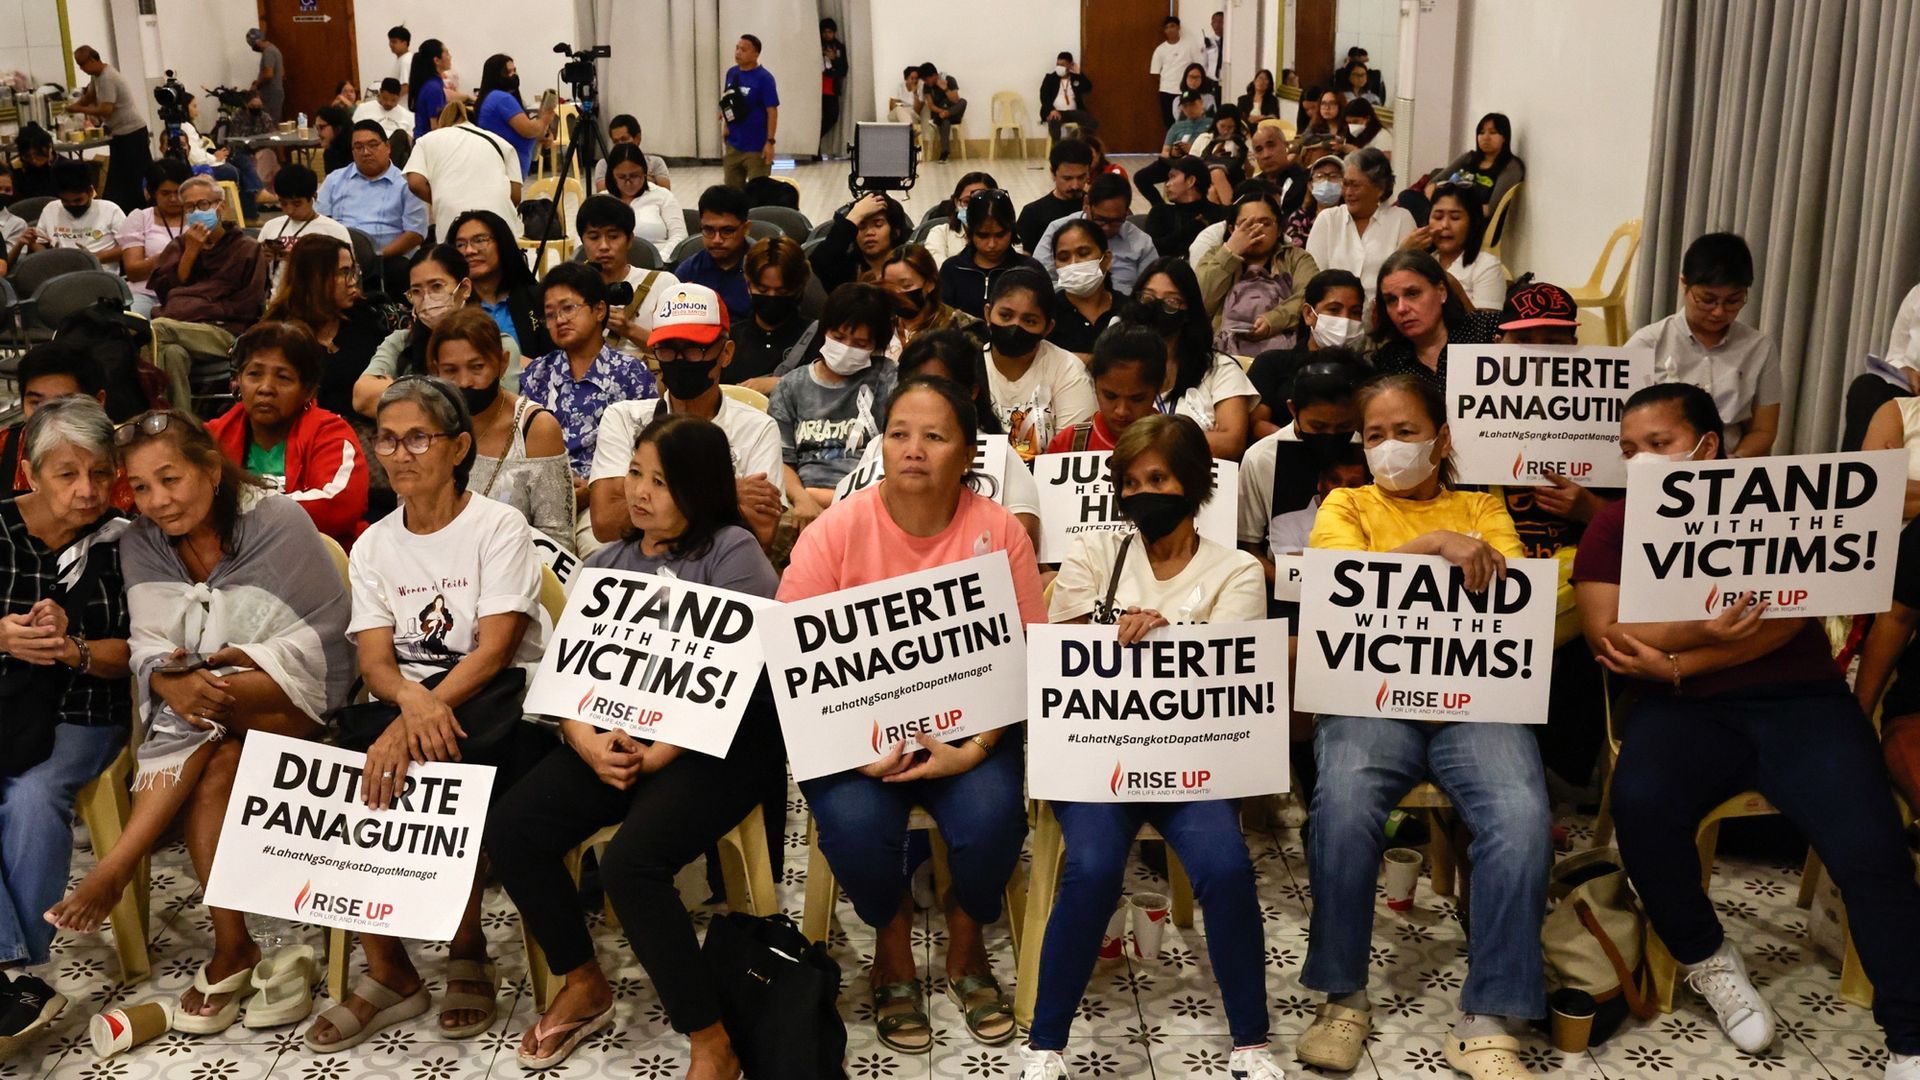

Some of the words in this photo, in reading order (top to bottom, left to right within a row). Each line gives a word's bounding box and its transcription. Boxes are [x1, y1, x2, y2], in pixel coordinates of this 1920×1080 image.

[672, 301, 708, 311] JONJON
[1476, 356, 1630, 389] DUTERTE
[1478, 430, 1620, 442] #LahatNgSangkotDapatManago
[1526, 461, 1567, 476] RISE
[1570, 462, 1593, 476] UP
[1656, 461, 1878, 518] STAND
[1684, 519, 1763, 535] WITH
[1789, 514, 1844, 531] THE
[1642, 530, 1878, 580] VICTIMS!
[442, 577, 469, 589] Faith
[1329, 559, 1532, 615] STAND
[1777, 590, 1808, 606] UP
[580, 577, 754, 644] STAND
[793, 572, 986, 654] DUTERTE
[1355, 613, 1429, 630] WITH
[1453, 617, 1502, 633] THE
[592, 623, 652, 646] WITH
[671, 638, 715, 660] THE
[784, 612, 1011, 699] PANAGUTIN!
[1061, 636, 1256, 679] DUTERTE
[1316, 629, 1533, 680] VICTIMS!
[556, 638, 738, 710] VICTIMS!
[821, 663, 993, 716] #LahatNgSangkotDapatManagot
[592, 696, 638, 721] RISE
[638, 708, 663, 726] UP
[1042, 681, 1274, 721] PANAGUTIN!
[1392, 690, 1439, 707] RISE
[1443, 692, 1471, 709] UP
[886, 716, 932, 744] RISE
[935, 709, 963, 731] UP
[1068, 730, 1250, 746] #LahatNgSangkotDapatManagot
[273, 752, 462, 815] DUTRTE
[1127, 771, 1177, 788] RISE
[1182, 770, 1211, 789] UP
[241, 795, 469, 859] PANAGUTIN!
[262, 845, 438, 880] #LahatNgSangkotDapatManagot
[312, 892, 363, 917] RISE
[366, 902, 394, 921] UP
[339, 916, 352, 924] AND
[353, 918, 366, 926] FOR
[367, 921, 391, 929] RGHTS!
